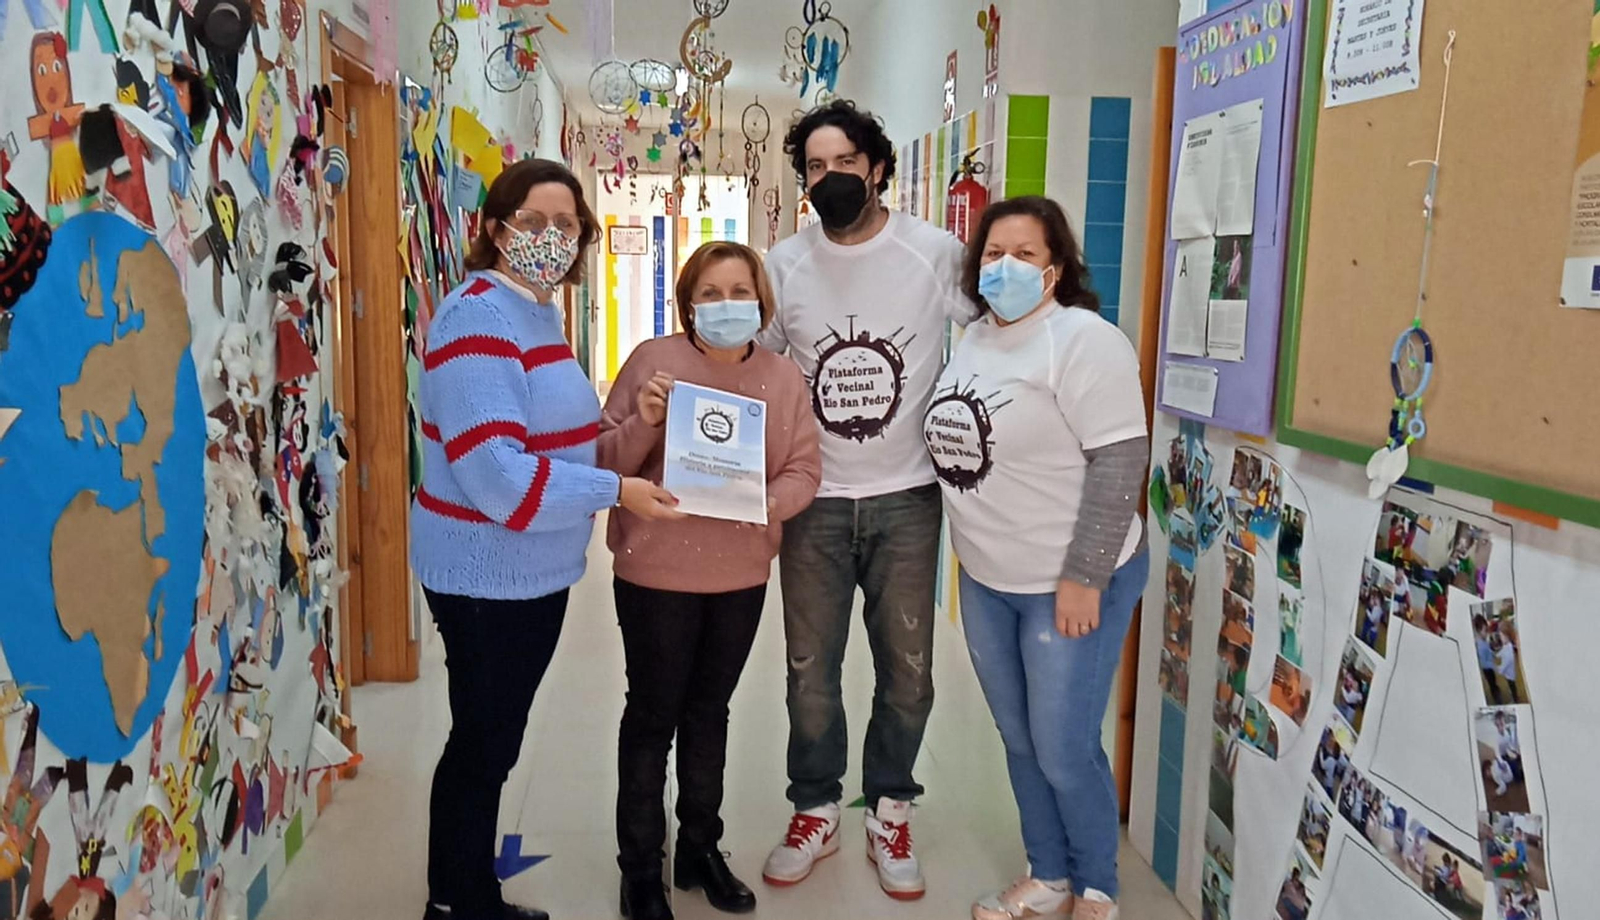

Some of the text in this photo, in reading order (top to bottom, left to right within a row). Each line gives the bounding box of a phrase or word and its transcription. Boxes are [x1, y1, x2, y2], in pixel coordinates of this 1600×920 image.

[828, 364, 884, 379] Plataforma
[837, 380, 874, 393] Vecinal
[840, 397, 860, 408] San
[862, 393, 892, 407] Pedro
[930, 415, 971, 431] Plataforma
[935, 431, 964, 445] Vecinal
[942, 445, 957, 456] San
